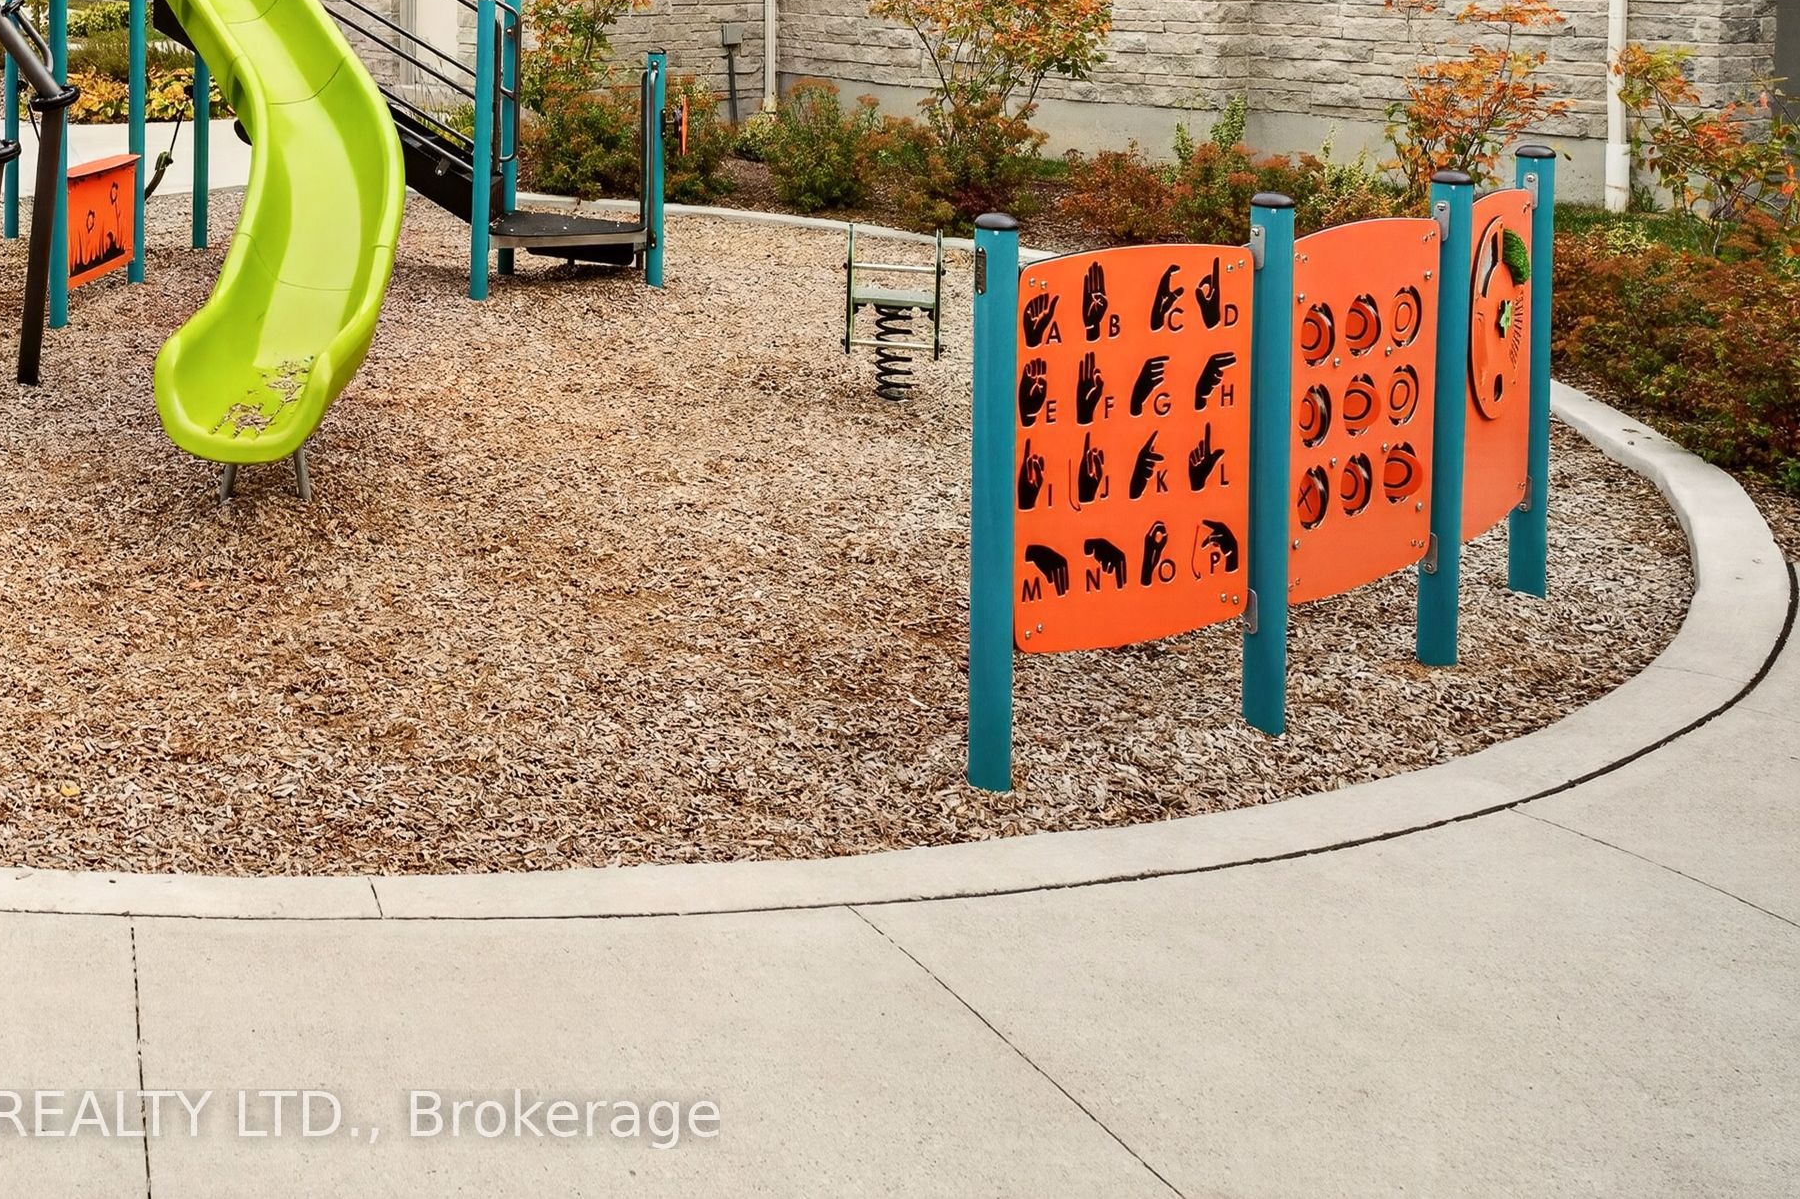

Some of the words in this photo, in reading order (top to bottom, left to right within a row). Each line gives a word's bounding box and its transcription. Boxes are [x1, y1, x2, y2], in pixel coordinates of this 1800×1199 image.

[1045, 320, 1062, 345] A
[1108, 313, 1121, 338] B
[1167, 307, 1185, 332] C
[1223, 303, 1239, 327] D
[1045, 399, 1058, 423] E
[1104, 396, 1115, 419] F
[1153, 392, 1172, 416] G
[1220, 383, 1235, 407] H
[1047, 483, 1053, 508] I
[1100, 474, 1110, 499] J
[1156, 469, 1169, 493] K
[1219, 463, 1230, 486] L
[1021, 576, 1043, 603] M
[1085, 567, 1101, 593] N
[1157, 558, 1176, 583] O
[1209, 551, 1221, 575] P
